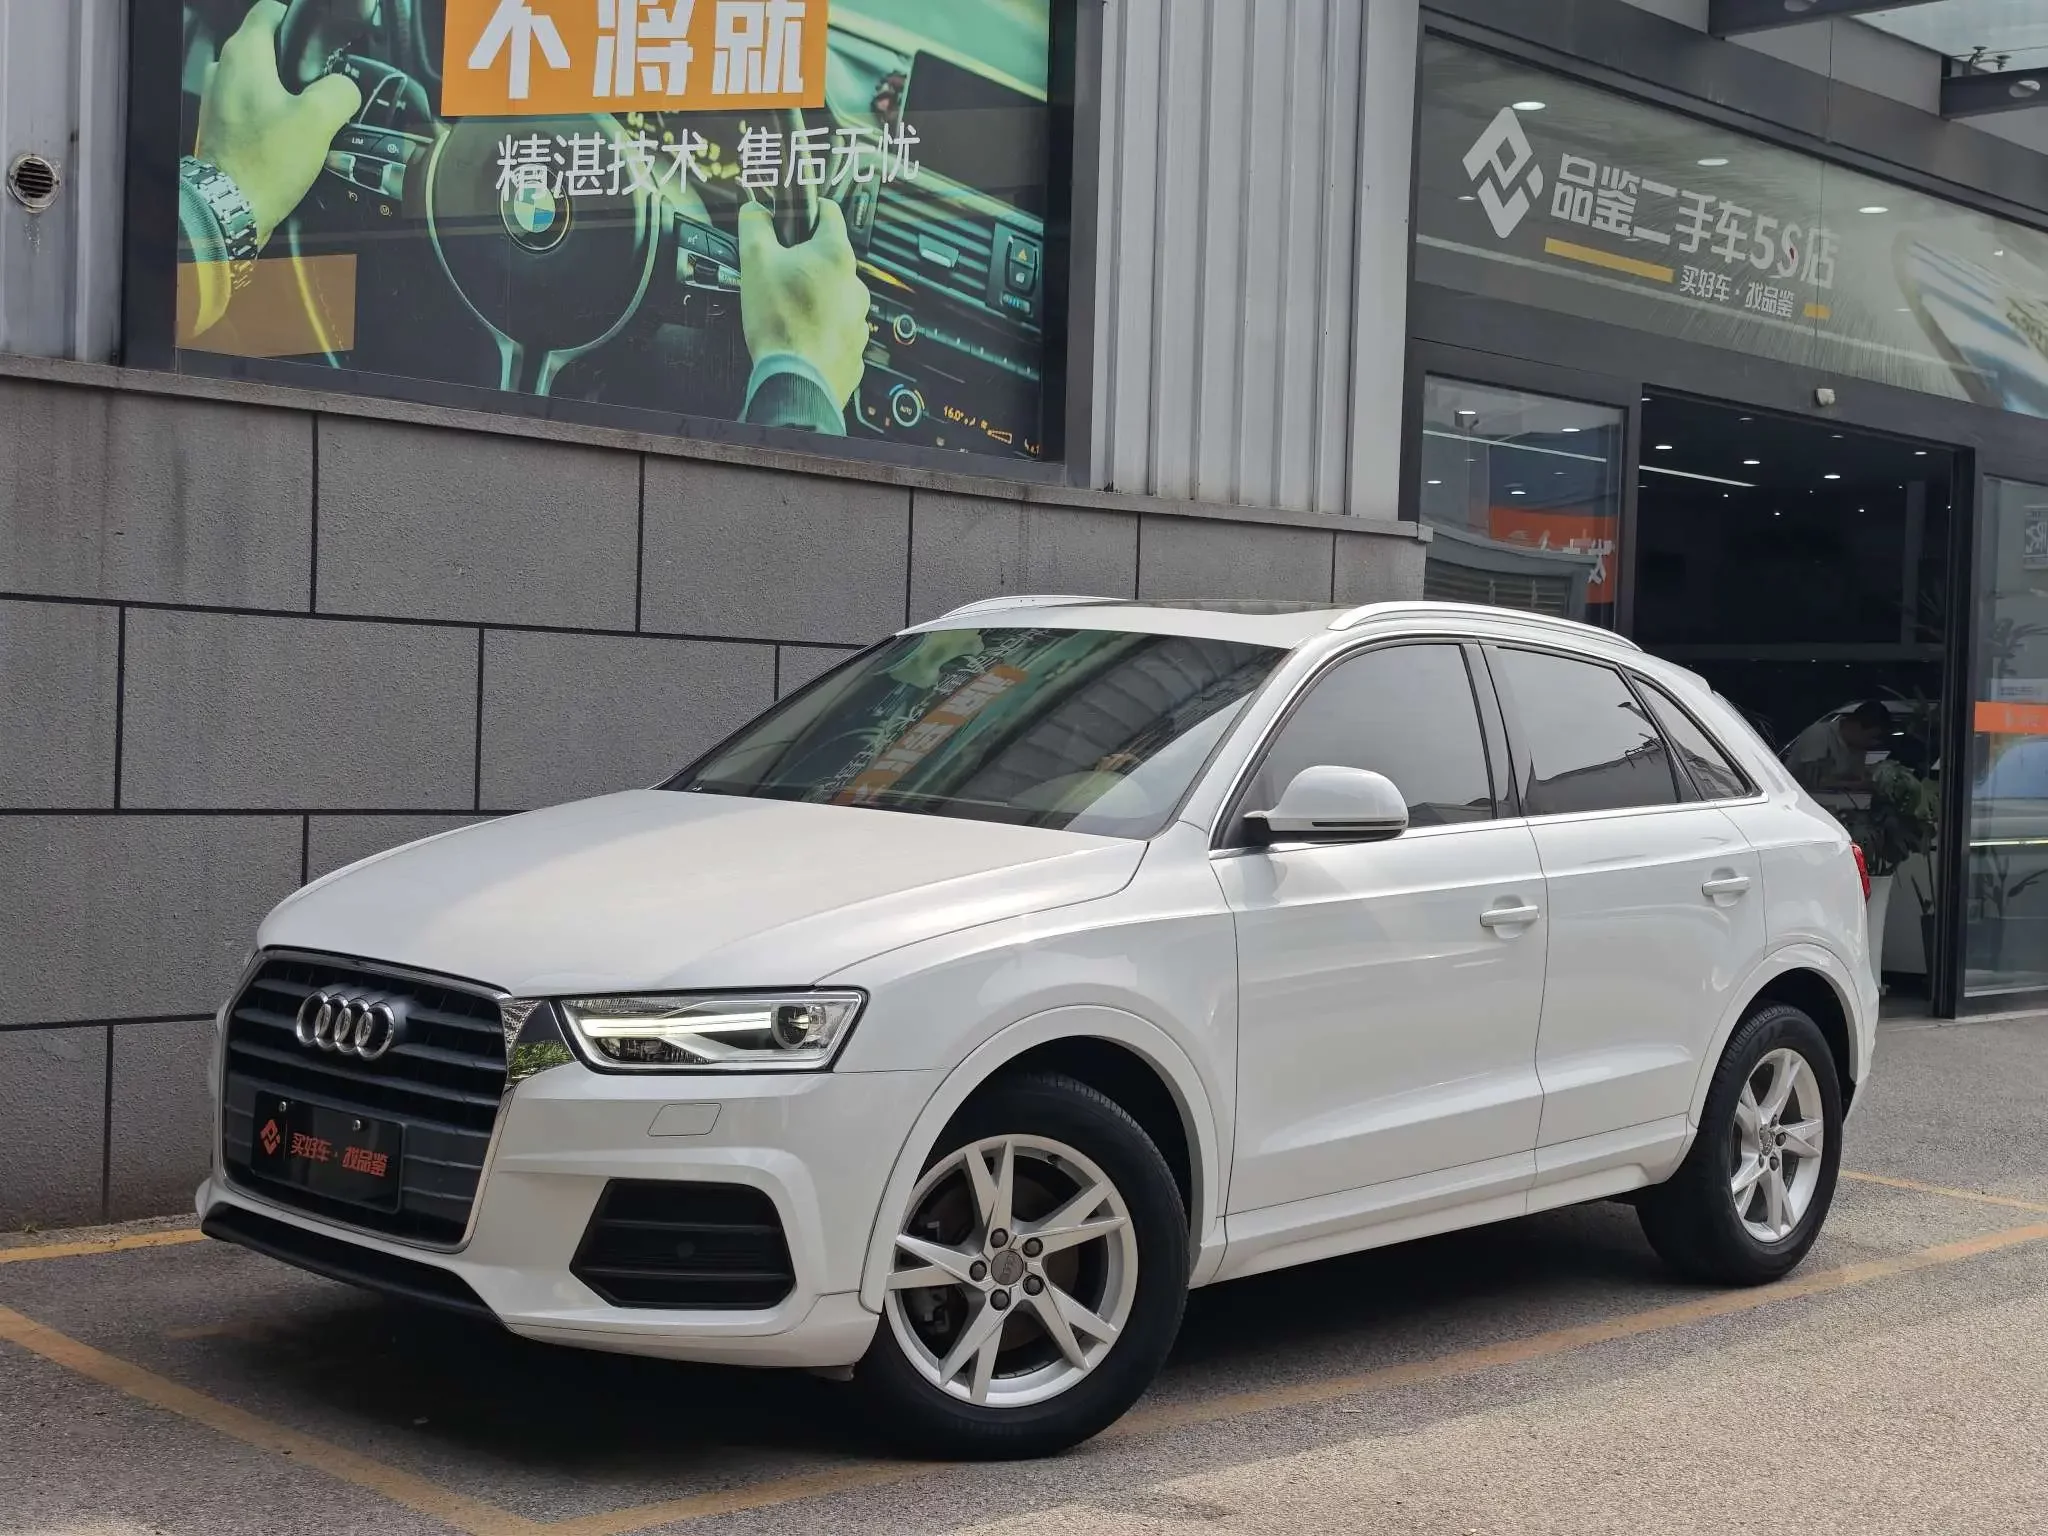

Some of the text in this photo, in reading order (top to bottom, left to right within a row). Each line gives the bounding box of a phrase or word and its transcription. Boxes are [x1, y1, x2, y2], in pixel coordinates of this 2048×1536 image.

[467, 0, 805, 99] 不将就
[496, 123, 920, 201] 精湛技术 售后无忧
[1551, 152, 1839, 289] 品鉴二手车5S店
